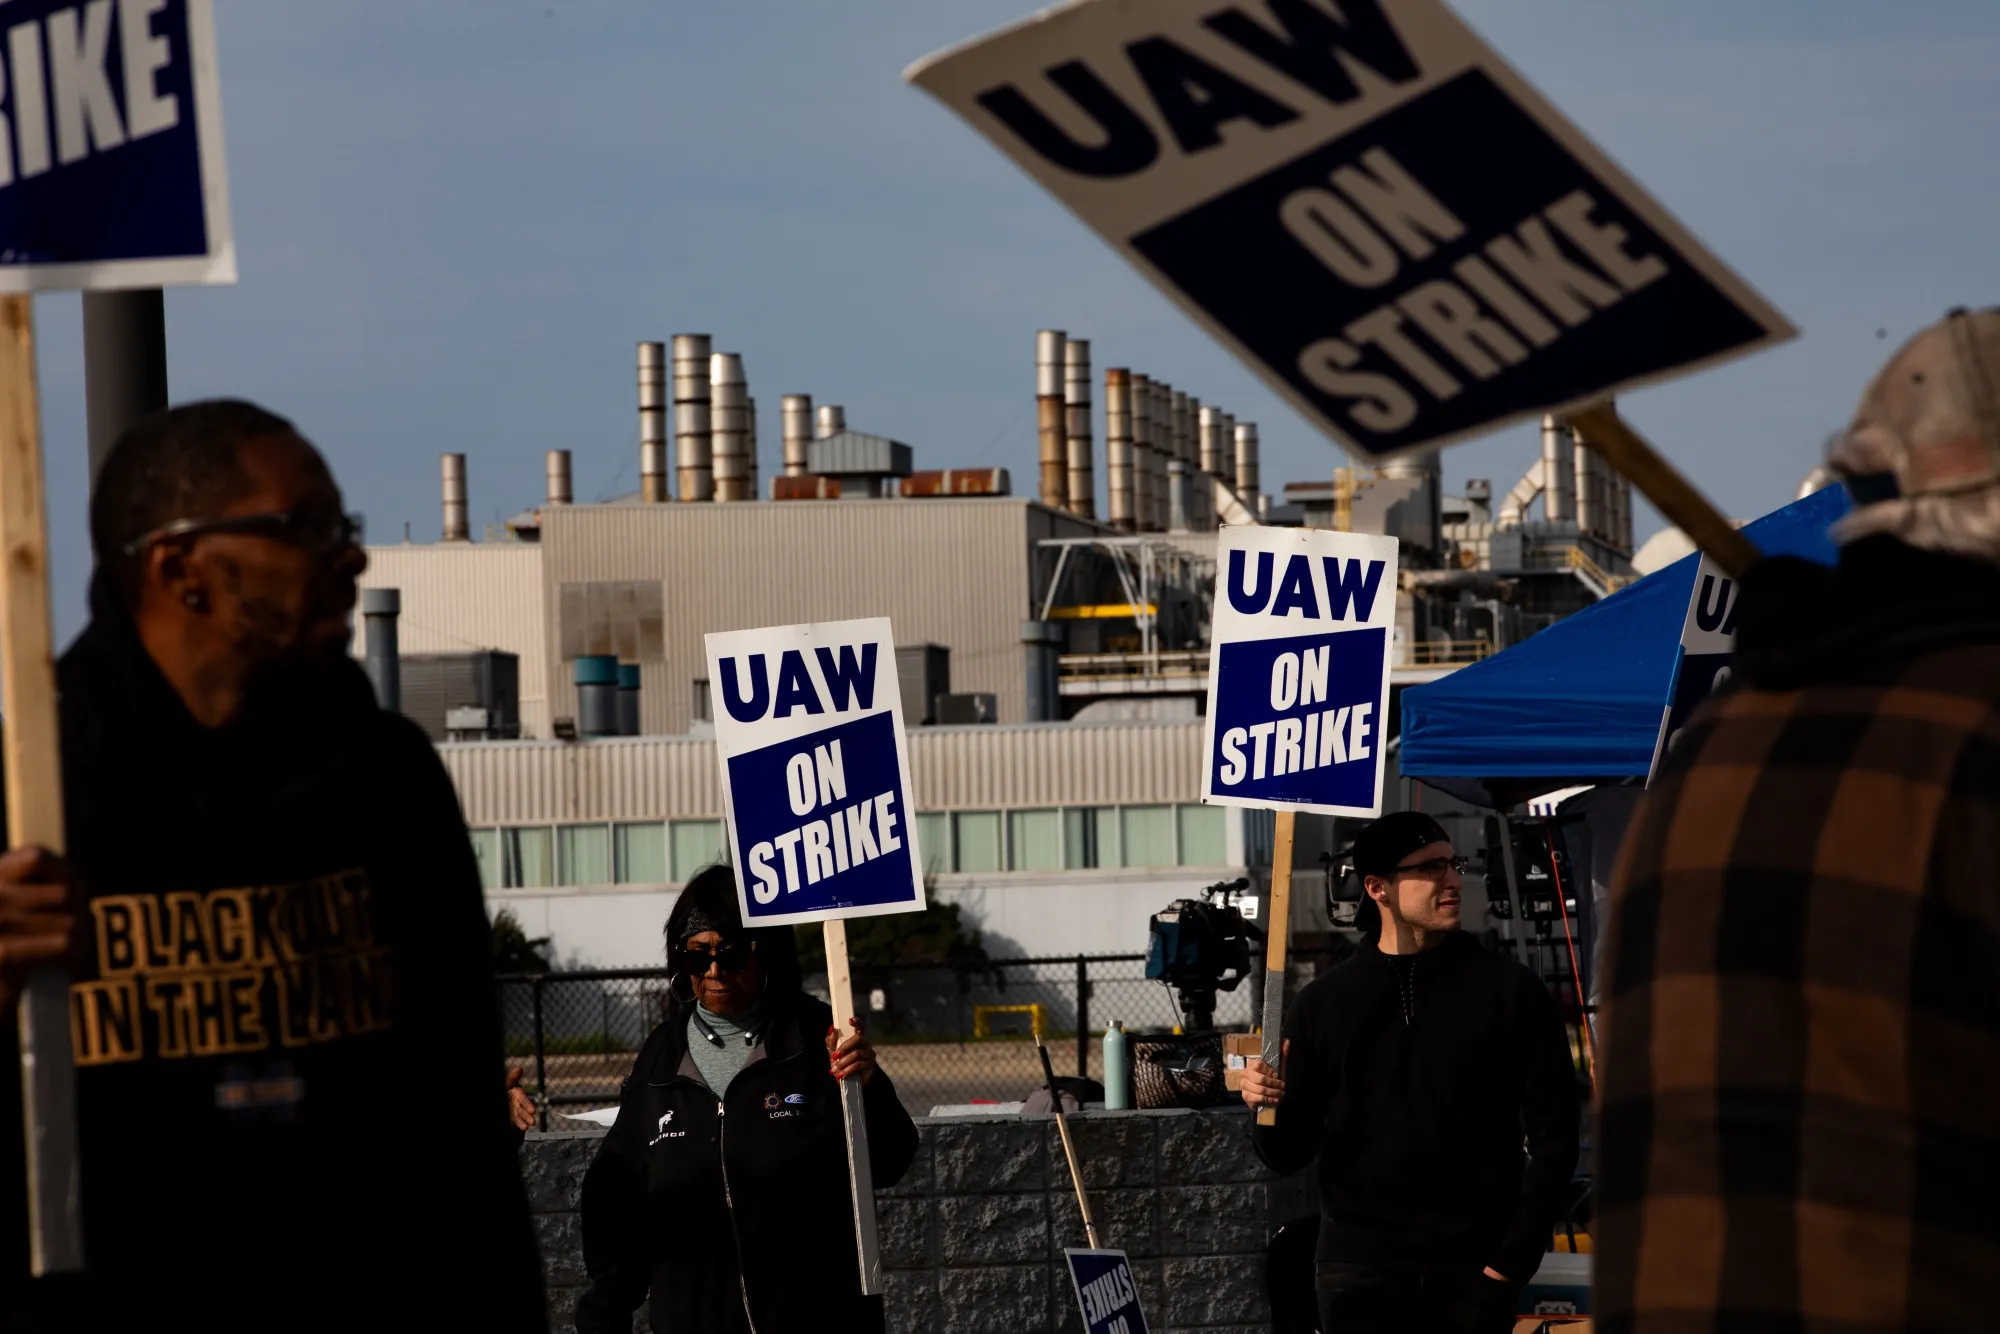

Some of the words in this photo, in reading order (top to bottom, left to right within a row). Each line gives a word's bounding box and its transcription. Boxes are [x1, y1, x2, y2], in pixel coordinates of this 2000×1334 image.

[0, 0, 180, 189] IKE
[974, 0, 1423, 179] UAW
[1279, 147, 1467, 289] ON
[1297, 189, 1669, 433] STRIKE
[1227, 549, 1386, 623] UAW
[718, 642, 878, 723] UAW
[1270, 645, 1331, 712] ON
[786, 738, 847, 816] ON
[1220, 701, 1373, 786] STRIKE
[748, 790, 902, 905] STRIKE
[69, 977, 145, 1067] IN
[144, 968, 271, 1061] THE
[769, 1110, 794, 1119] LOCAL
[1081, 1263, 1135, 1326] STRIKE
